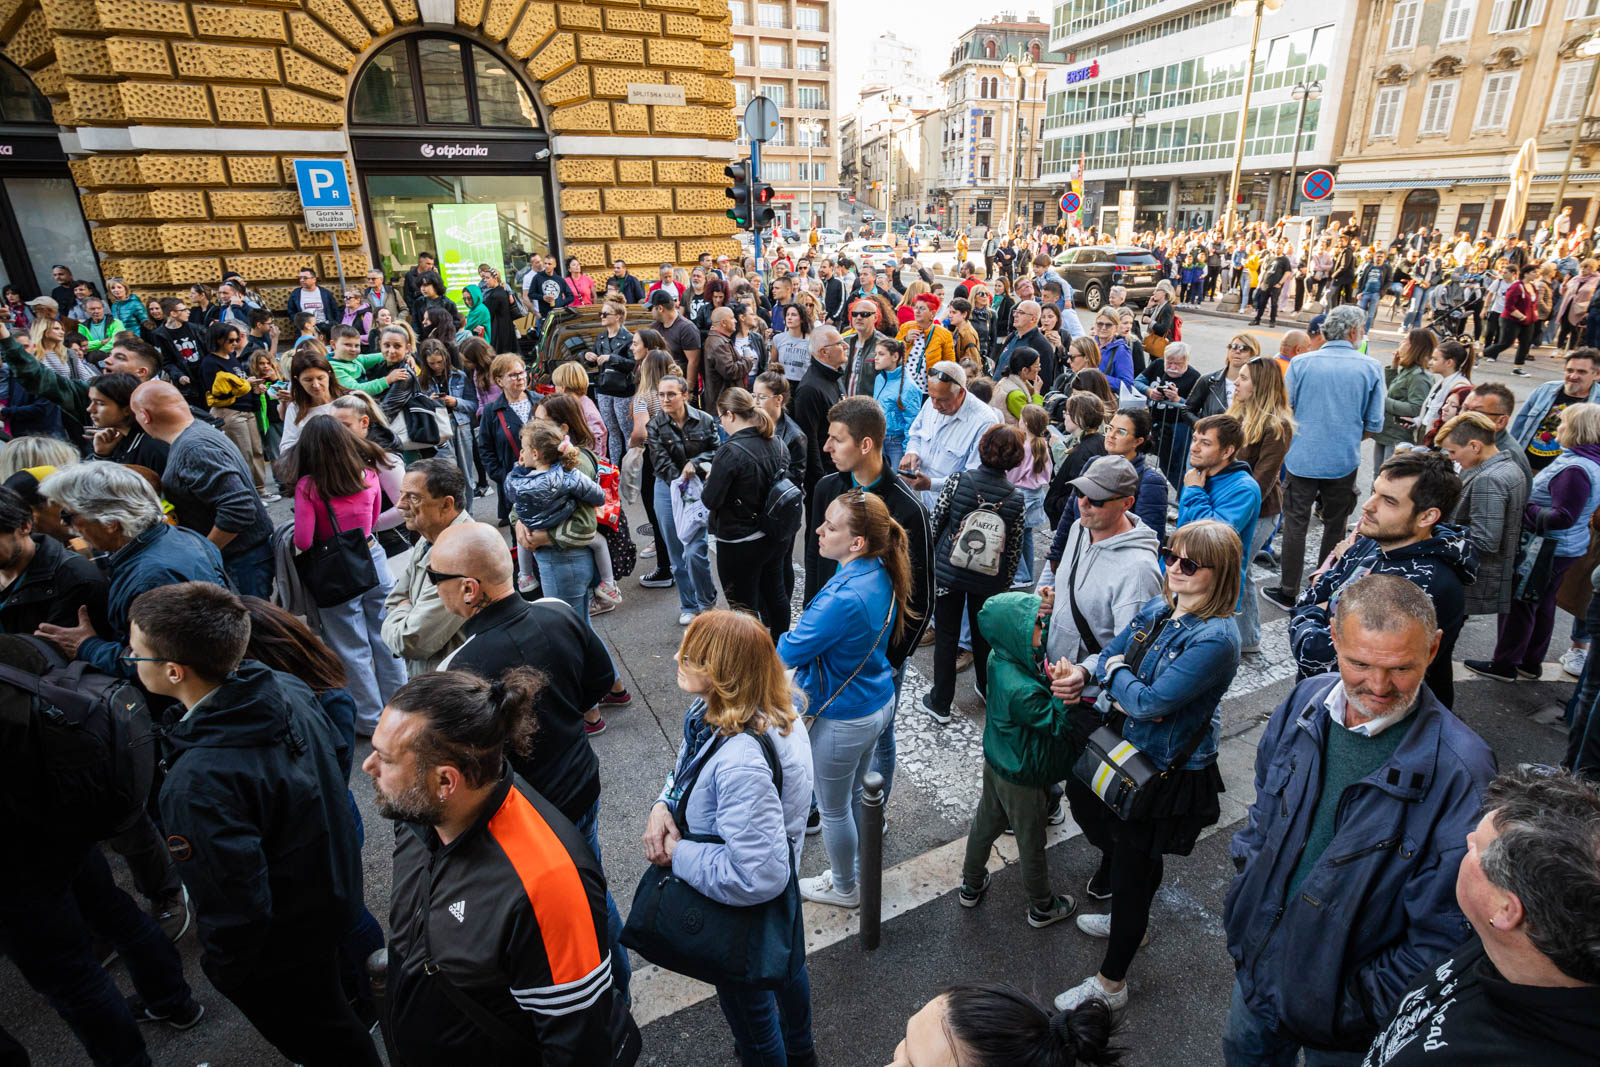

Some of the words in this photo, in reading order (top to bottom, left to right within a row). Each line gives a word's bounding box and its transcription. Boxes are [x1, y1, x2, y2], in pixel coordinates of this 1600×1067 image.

[1066, 66, 1090, 84] ERSTE
[436, 143, 489, 159] otpbanka
[309, 168, 335, 199] P
[331, 189, 340, 199] R
[310, 221, 354, 229] spasavanja
